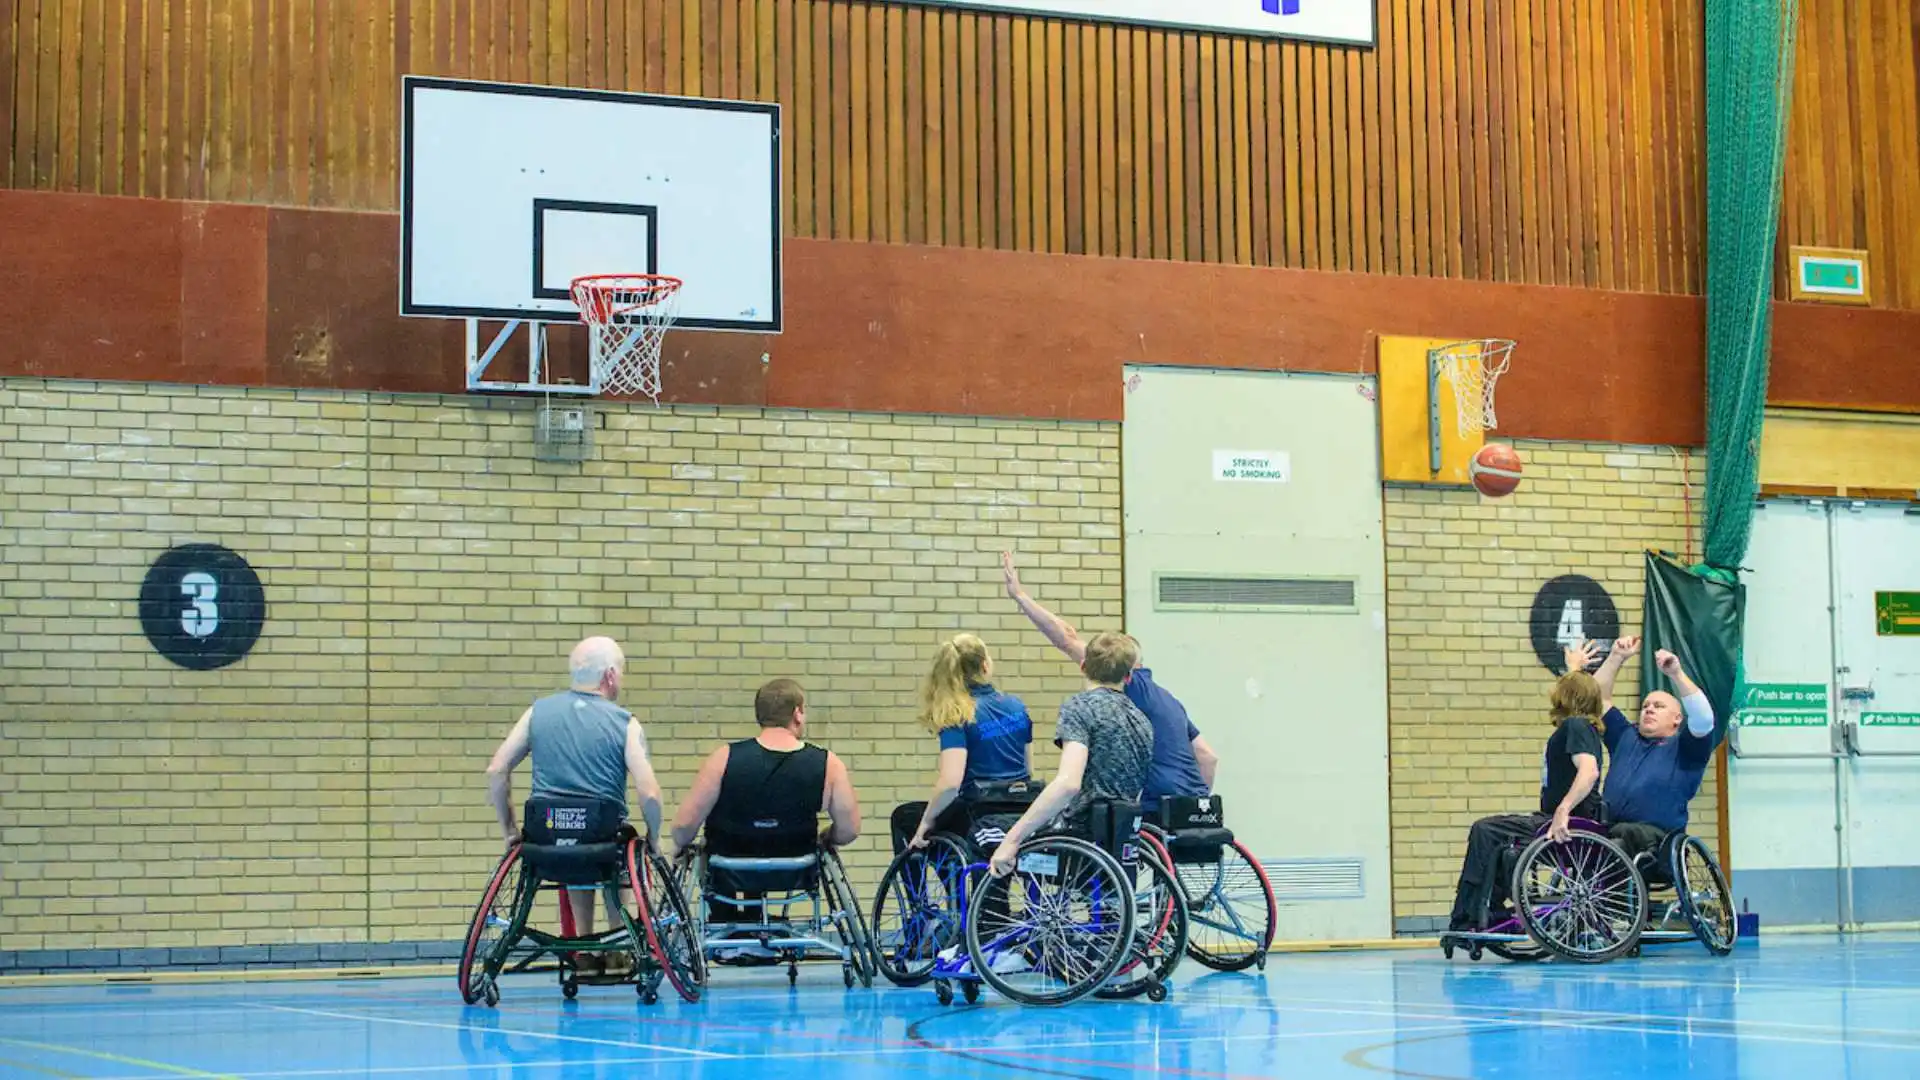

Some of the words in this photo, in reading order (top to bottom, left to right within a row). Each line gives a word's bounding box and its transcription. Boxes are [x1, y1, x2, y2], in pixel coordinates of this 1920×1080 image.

[1232, 458, 1270, 468] STRICTLY
[1222, 469, 1237, 478] NO
[1240, 469, 1281, 479] SMOKING
[181, 572, 218, 637] 3
[1557, 599, 1586, 652] 4
[1758, 690, 1778, 700] Push
[1780, 690, 1793, 700] bar
[1795, 691, 1804, 700] to
[1805, 692, 1826, 703] open
[1756, 715, 1777, 724] Push
[1778, 715, 1792, 724] bar
[1793, 715, 1802, 724] to
[1804, 716, 1824, 725] open
[1876, 714, 1896, 724] Push
[1897, 715, 1910, 724] bar
